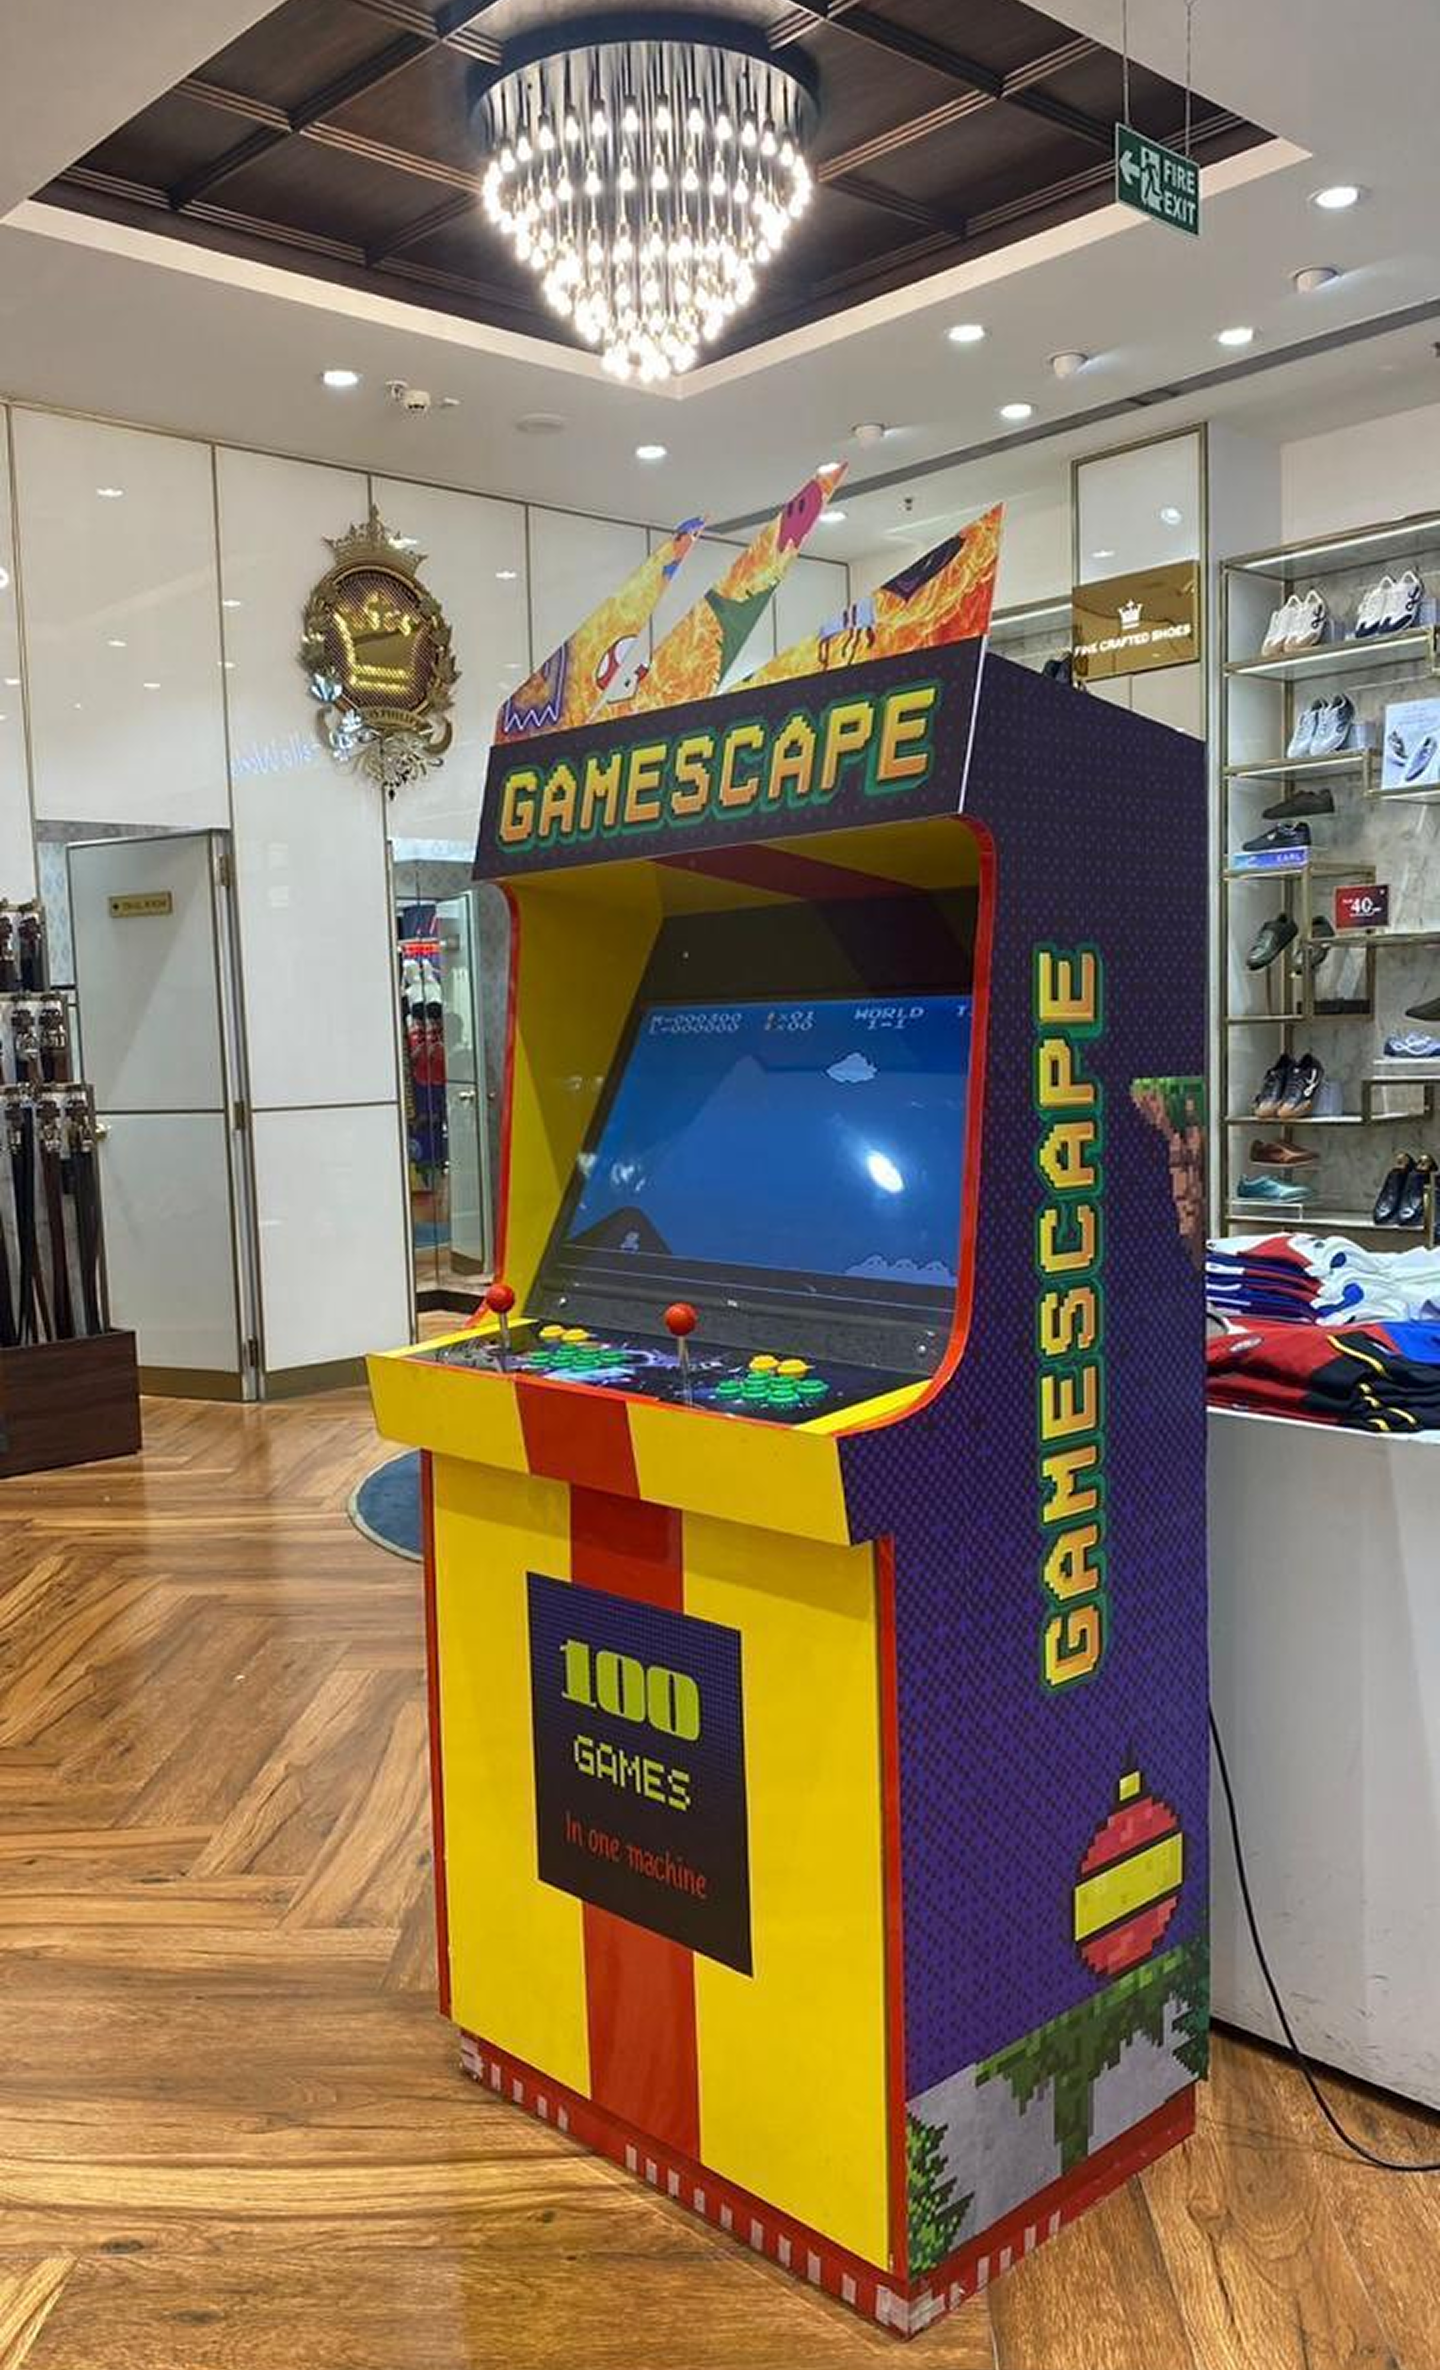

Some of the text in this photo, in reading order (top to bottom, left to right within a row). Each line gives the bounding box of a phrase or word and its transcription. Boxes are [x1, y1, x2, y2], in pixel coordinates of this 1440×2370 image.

[1164, 160, 1195, 195] FIRE
[1164, 190, 1196, 225] EXIT
[1099, 632, 1150, 652] CRAFTED
[1151, 623, 1191, 642] SHOES
[499, 687, 937, 844] GAMESCAPE
[854, 1006, 925, 1019] WORLD
[867, 1018, 905, 1030] 1-1
[1038, 951, 1101, 1686] GAMESCAPE
[560, 1638, 701, 1742] 100
[573, 1734, 691, 1811] GAMES
[565, 1809, 708, 1899] In one machine
